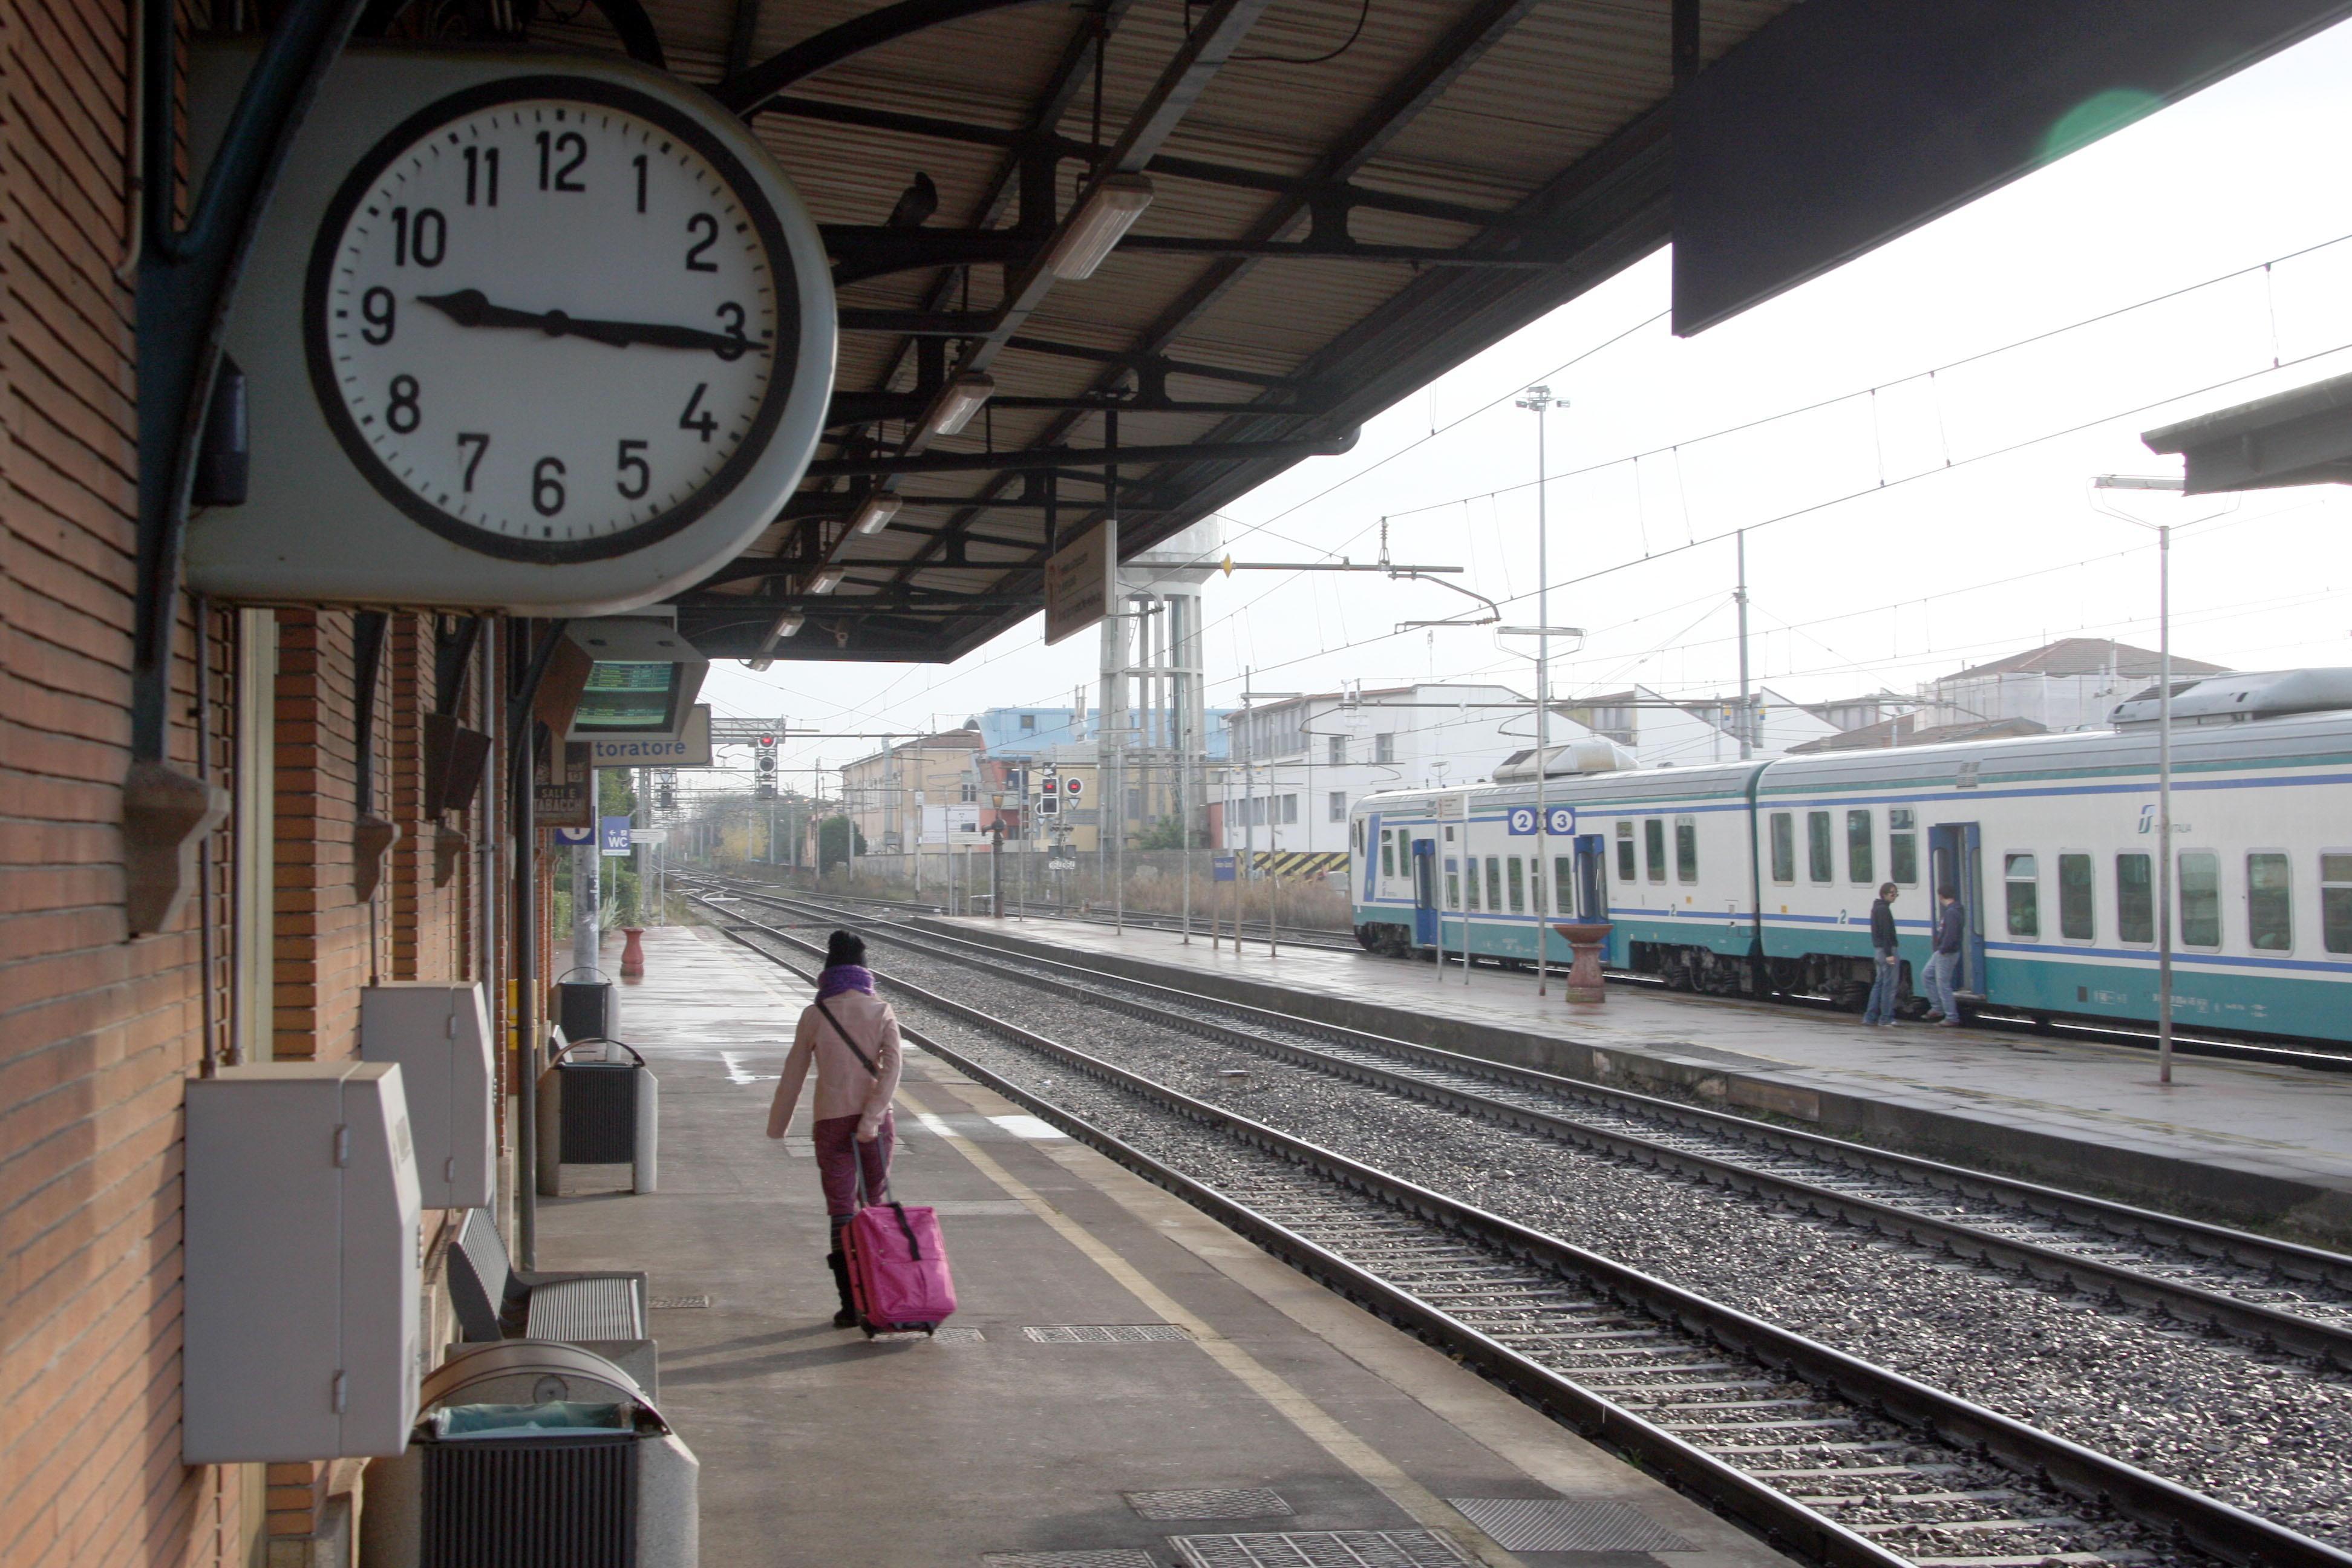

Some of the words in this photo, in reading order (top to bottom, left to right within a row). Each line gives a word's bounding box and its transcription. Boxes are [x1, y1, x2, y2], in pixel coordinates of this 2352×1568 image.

[463, 146, 499, 207] 11
[536, 131, 587, 192] 12
[633, 154, 647, 214] 1
[391, 206, 446, 268] 10
[685, 212, 718, 273] 2
[361, 286, 396, 346] 9
[714, 302, 746, 362] 3
[385, 374, 421, 435] 8
[679, 383, 718, 442] 4
[457, 432, 490, 493] 7
[532, 456, 566, 517] 6
[616, 439, 650, 500] 5
[596, 740, 686, 757] toratore
[542, 788, 564, 798] SALI
[569, 788, 577, 798] E
[1517, 814, 1528, 828] 2
[1557, 814, 1567, 828] 3
[608, 837, 628, 848] WC
[1671, 903, 1676, 916] 2
[1840, 909, 1846, 924] 2
